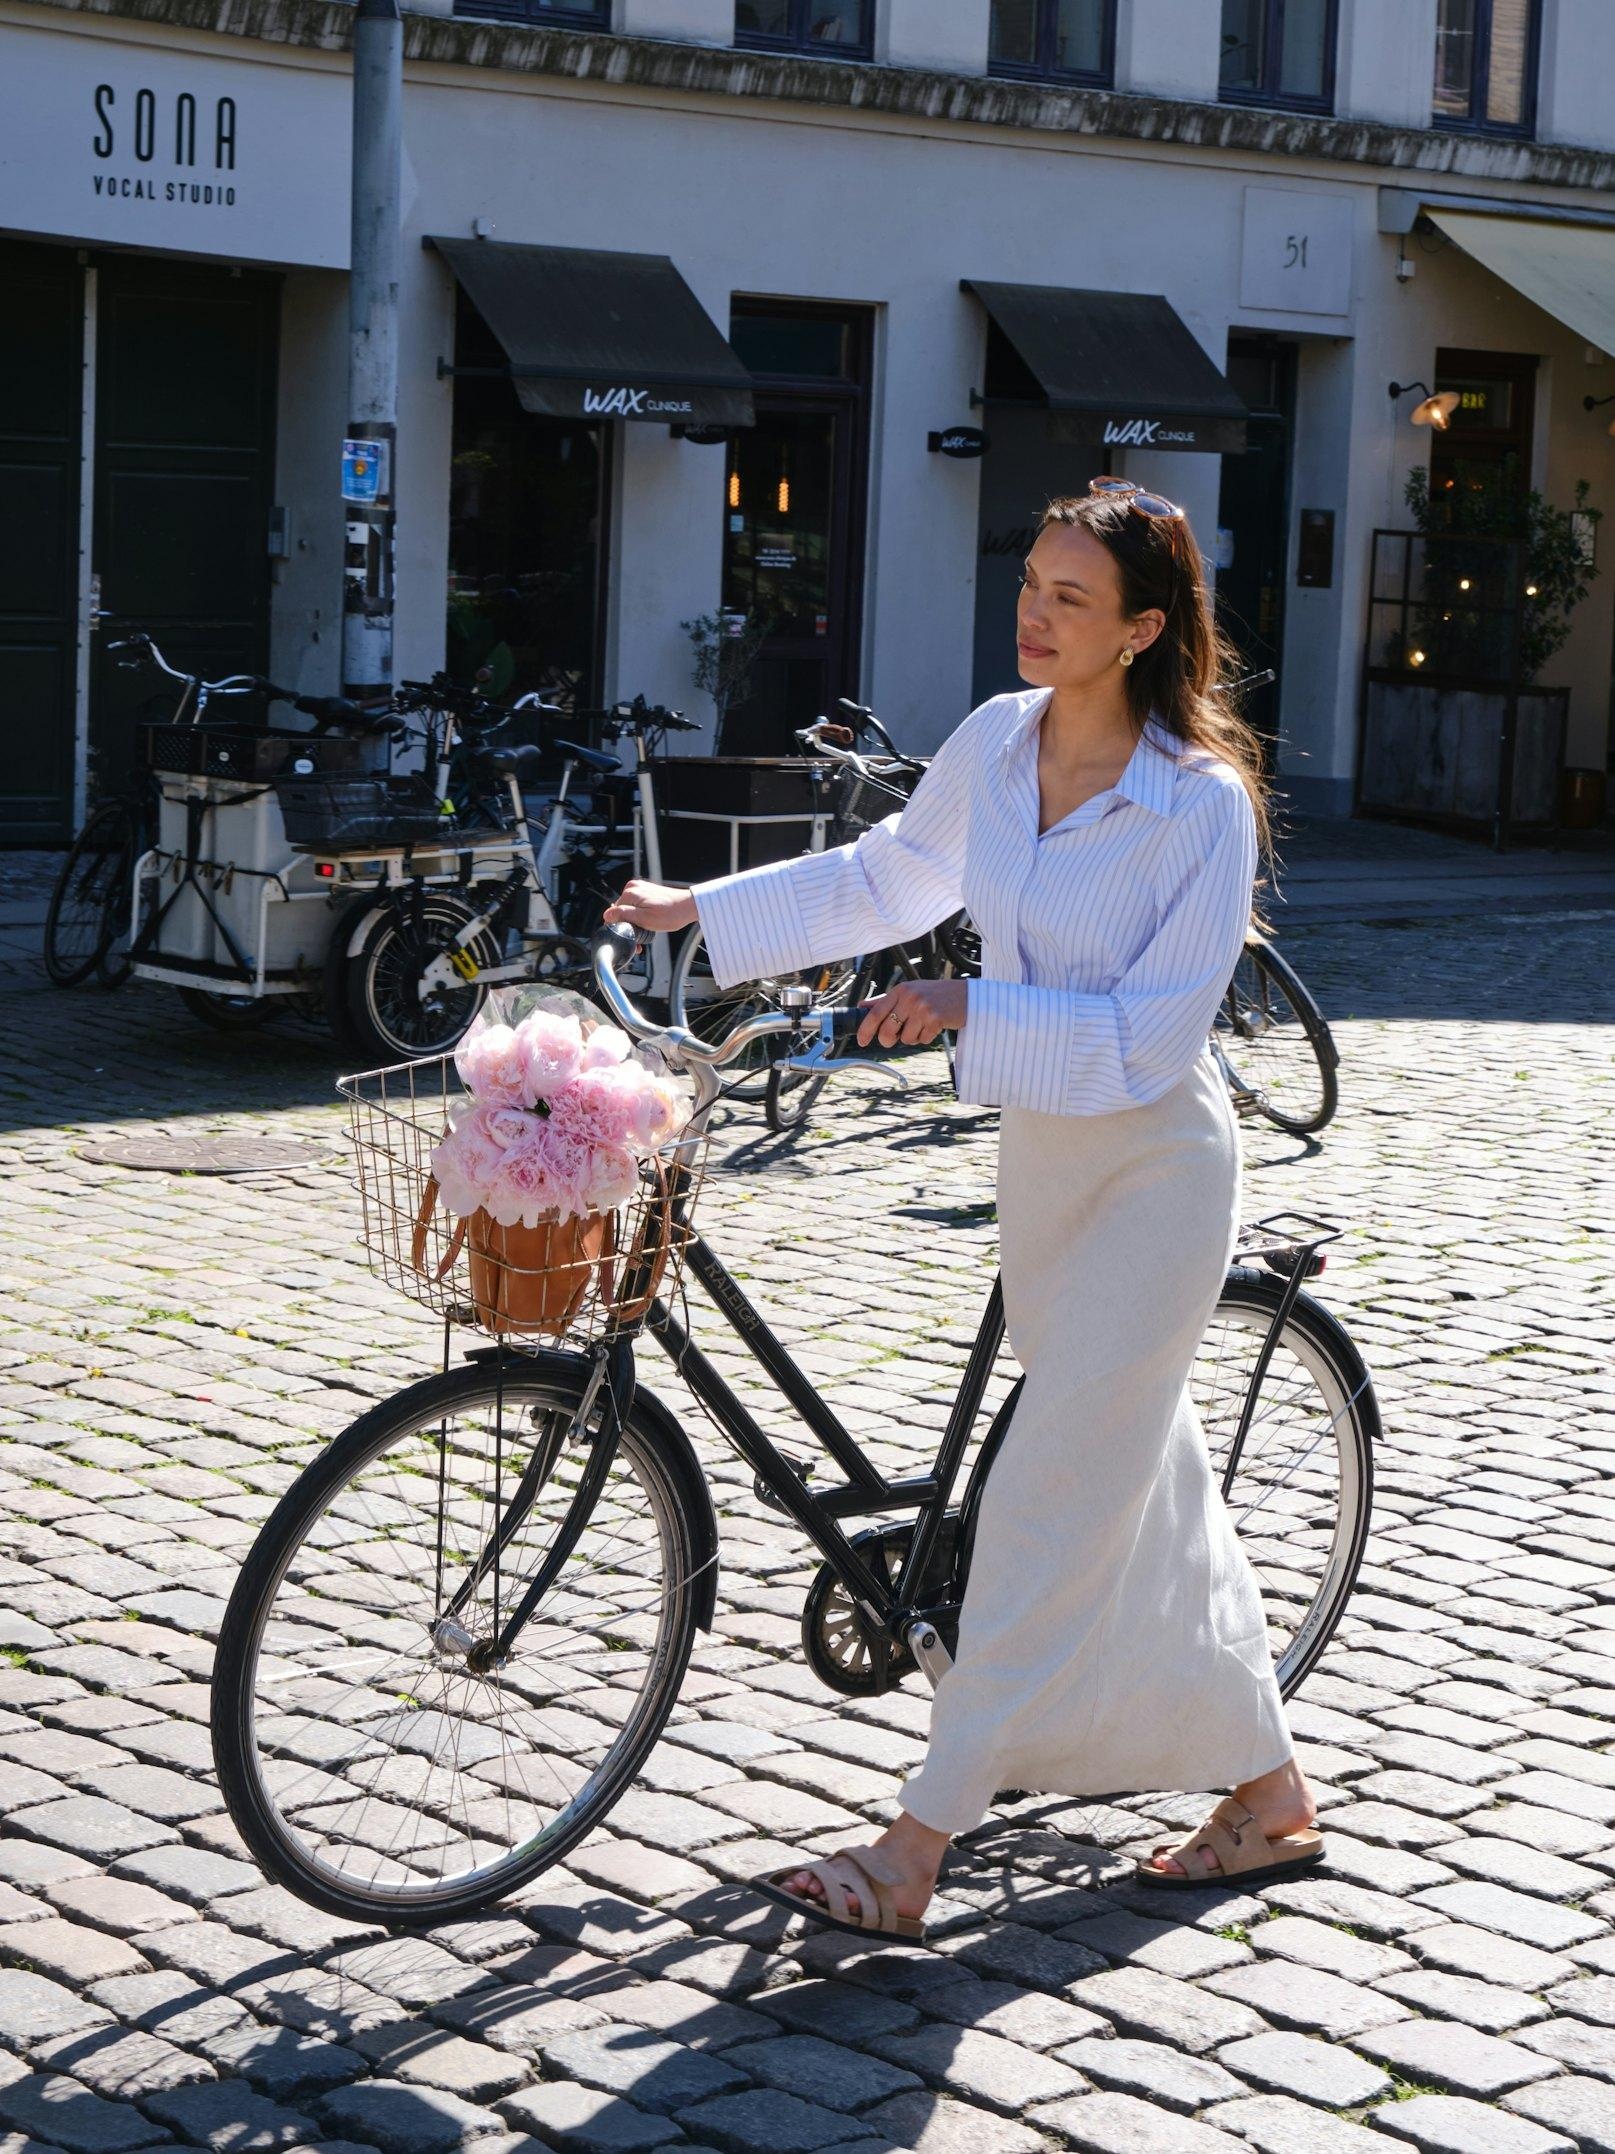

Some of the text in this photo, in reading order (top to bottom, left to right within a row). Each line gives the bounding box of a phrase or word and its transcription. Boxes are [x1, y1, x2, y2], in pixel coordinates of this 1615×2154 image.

[94, 84, 236, 170] SONA
[94, 175, 236, 206] VOCAL STUDIO
[1283, 235, 1309, 269] 51
[584, 387, 692, 416] WAX CLINIQUE
[1104, 419, 1196, 446] WAX CLINIQUE
[704, 1263, 760, 1331] RALEIGH
[1290, 1612, 1320, 1659] RALEIGH
